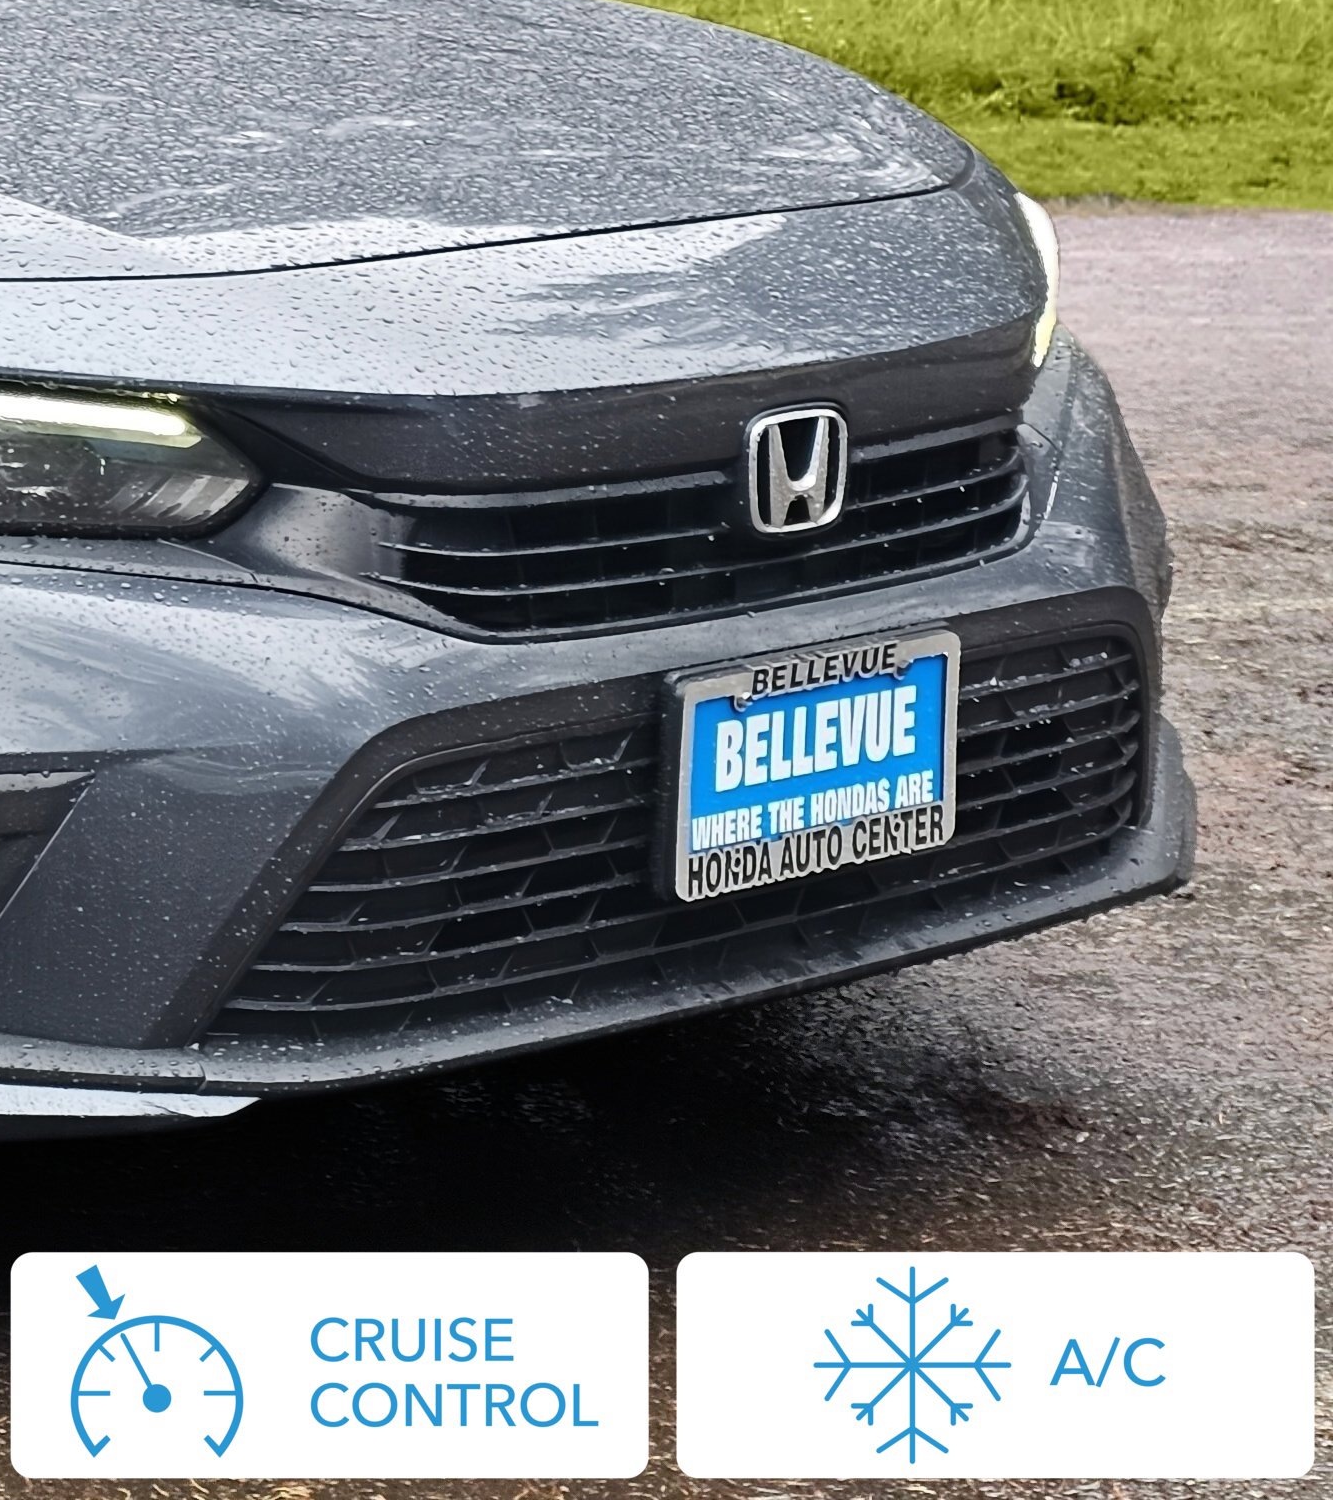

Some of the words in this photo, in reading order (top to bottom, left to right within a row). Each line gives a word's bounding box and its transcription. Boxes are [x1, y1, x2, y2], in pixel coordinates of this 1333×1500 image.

[751, 643, 898, 695] BELLEVUE
[714, 684, 917, 793] BELLEVUE
[688, 840, 773, 898] HONDA
[780, 829, 843, 877] AUTO
[852, 805, 944, 855] CENTER
[692, 807, 763, 851] WHERE
[768, 796, 805, 834] THE
[810, 781, 890, 825] HONDAS
[894, 770, 934, 808] ARE
